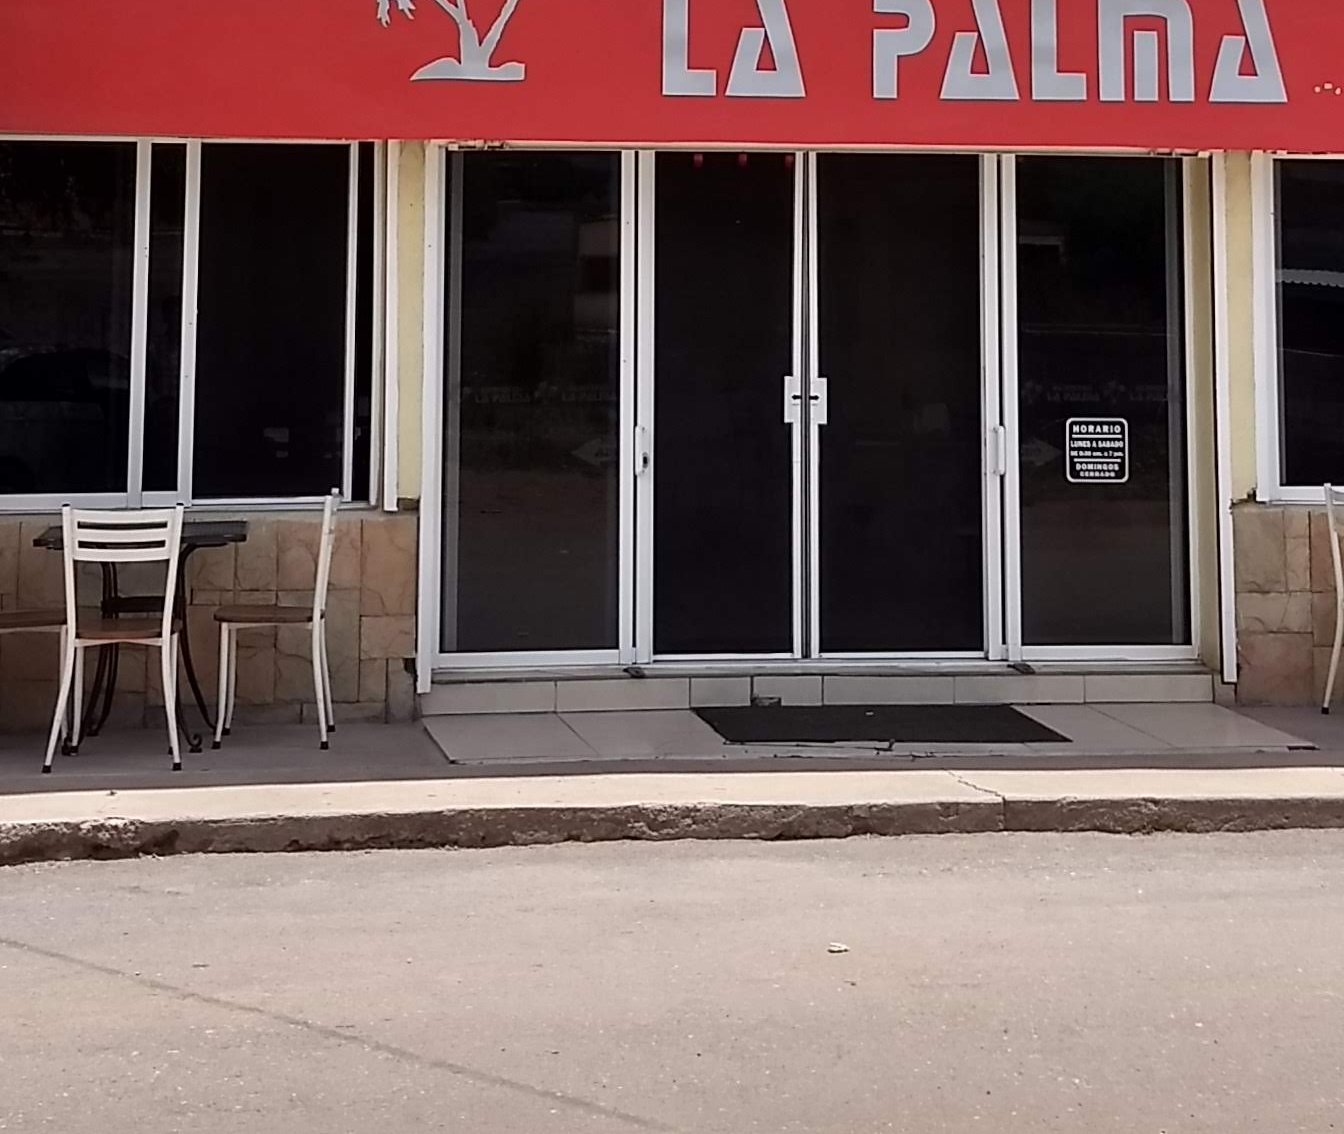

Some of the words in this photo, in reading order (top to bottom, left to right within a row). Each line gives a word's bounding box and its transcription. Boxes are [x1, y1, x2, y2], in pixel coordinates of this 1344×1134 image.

[1072, 424, 1121, 433] HORARIO
[1070, 440, 1091, 448] LUNES
[1092, 440, 1097, 448] A
[1075, 463, 1119, 471] DOMINGOS
